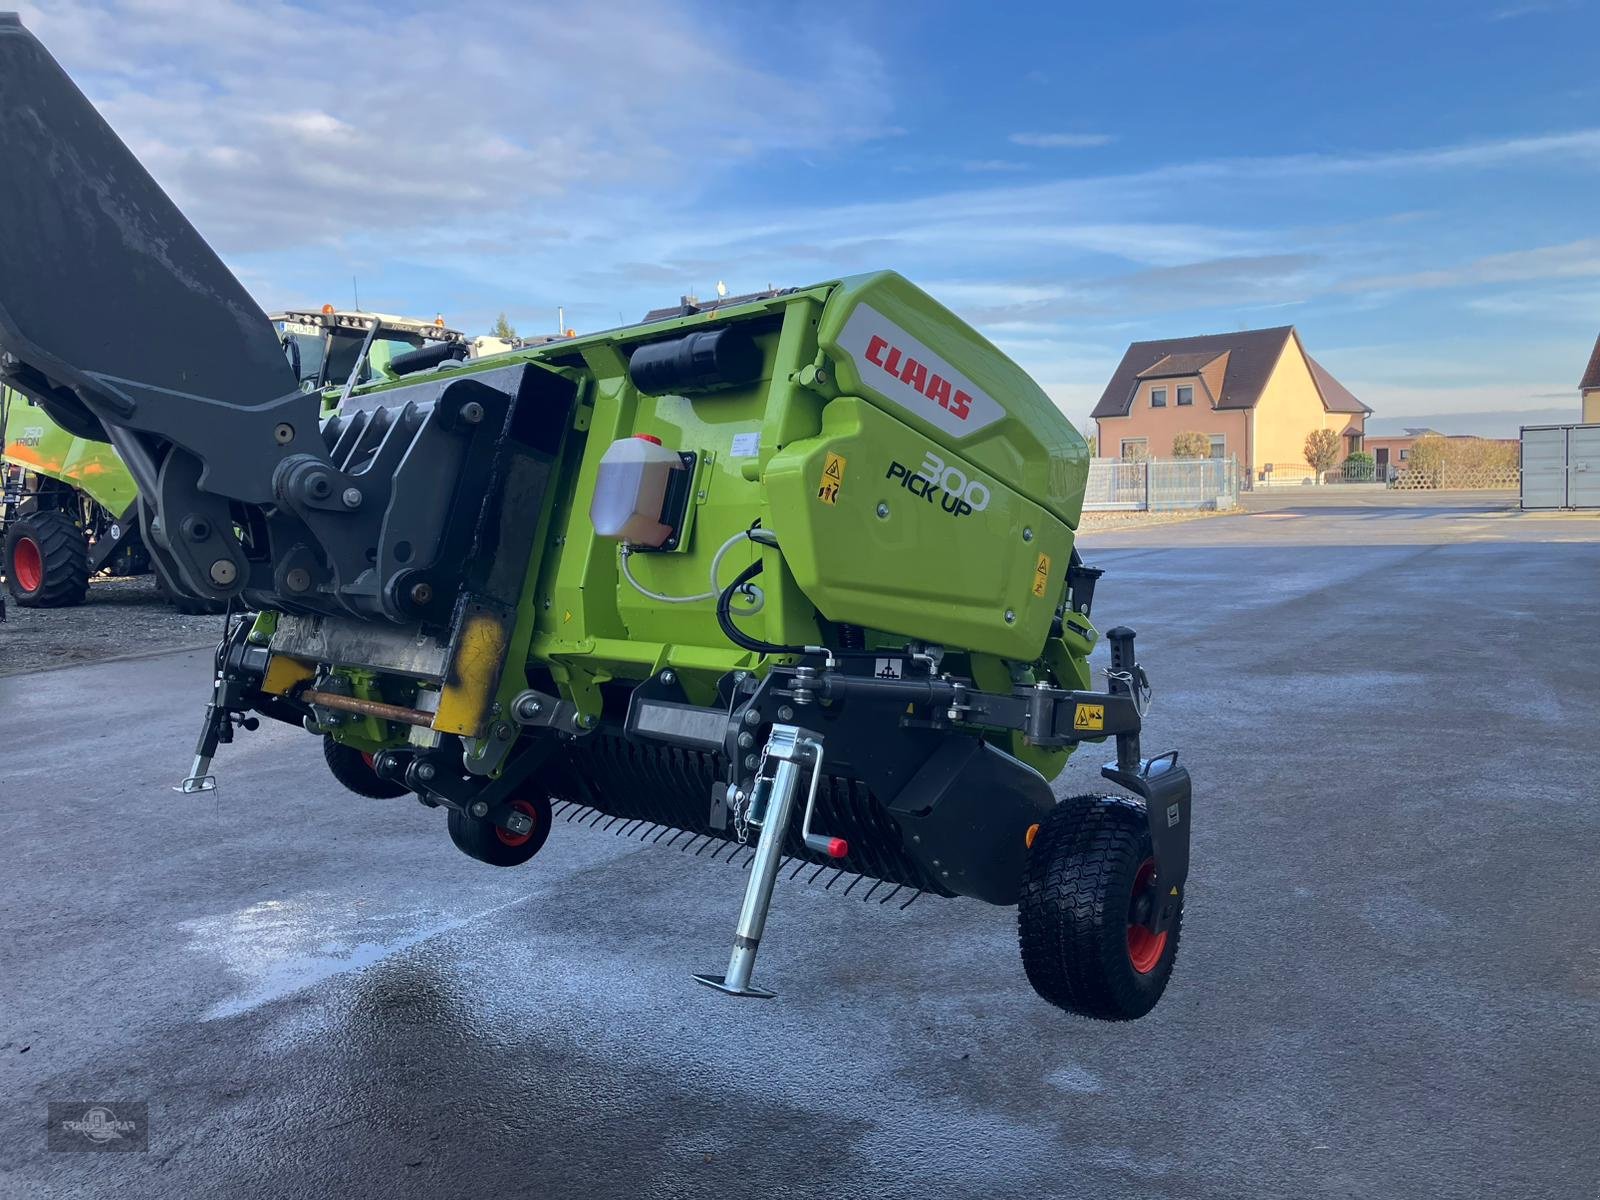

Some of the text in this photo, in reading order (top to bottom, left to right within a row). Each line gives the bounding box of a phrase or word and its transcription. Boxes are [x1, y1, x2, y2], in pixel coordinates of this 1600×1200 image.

[865, 335, 973, 421] CLAAS
[15, 437, 40, 447] TRION
[886, 461, 972, 517] PICK UP
[917, 451, 990, 511] 300
